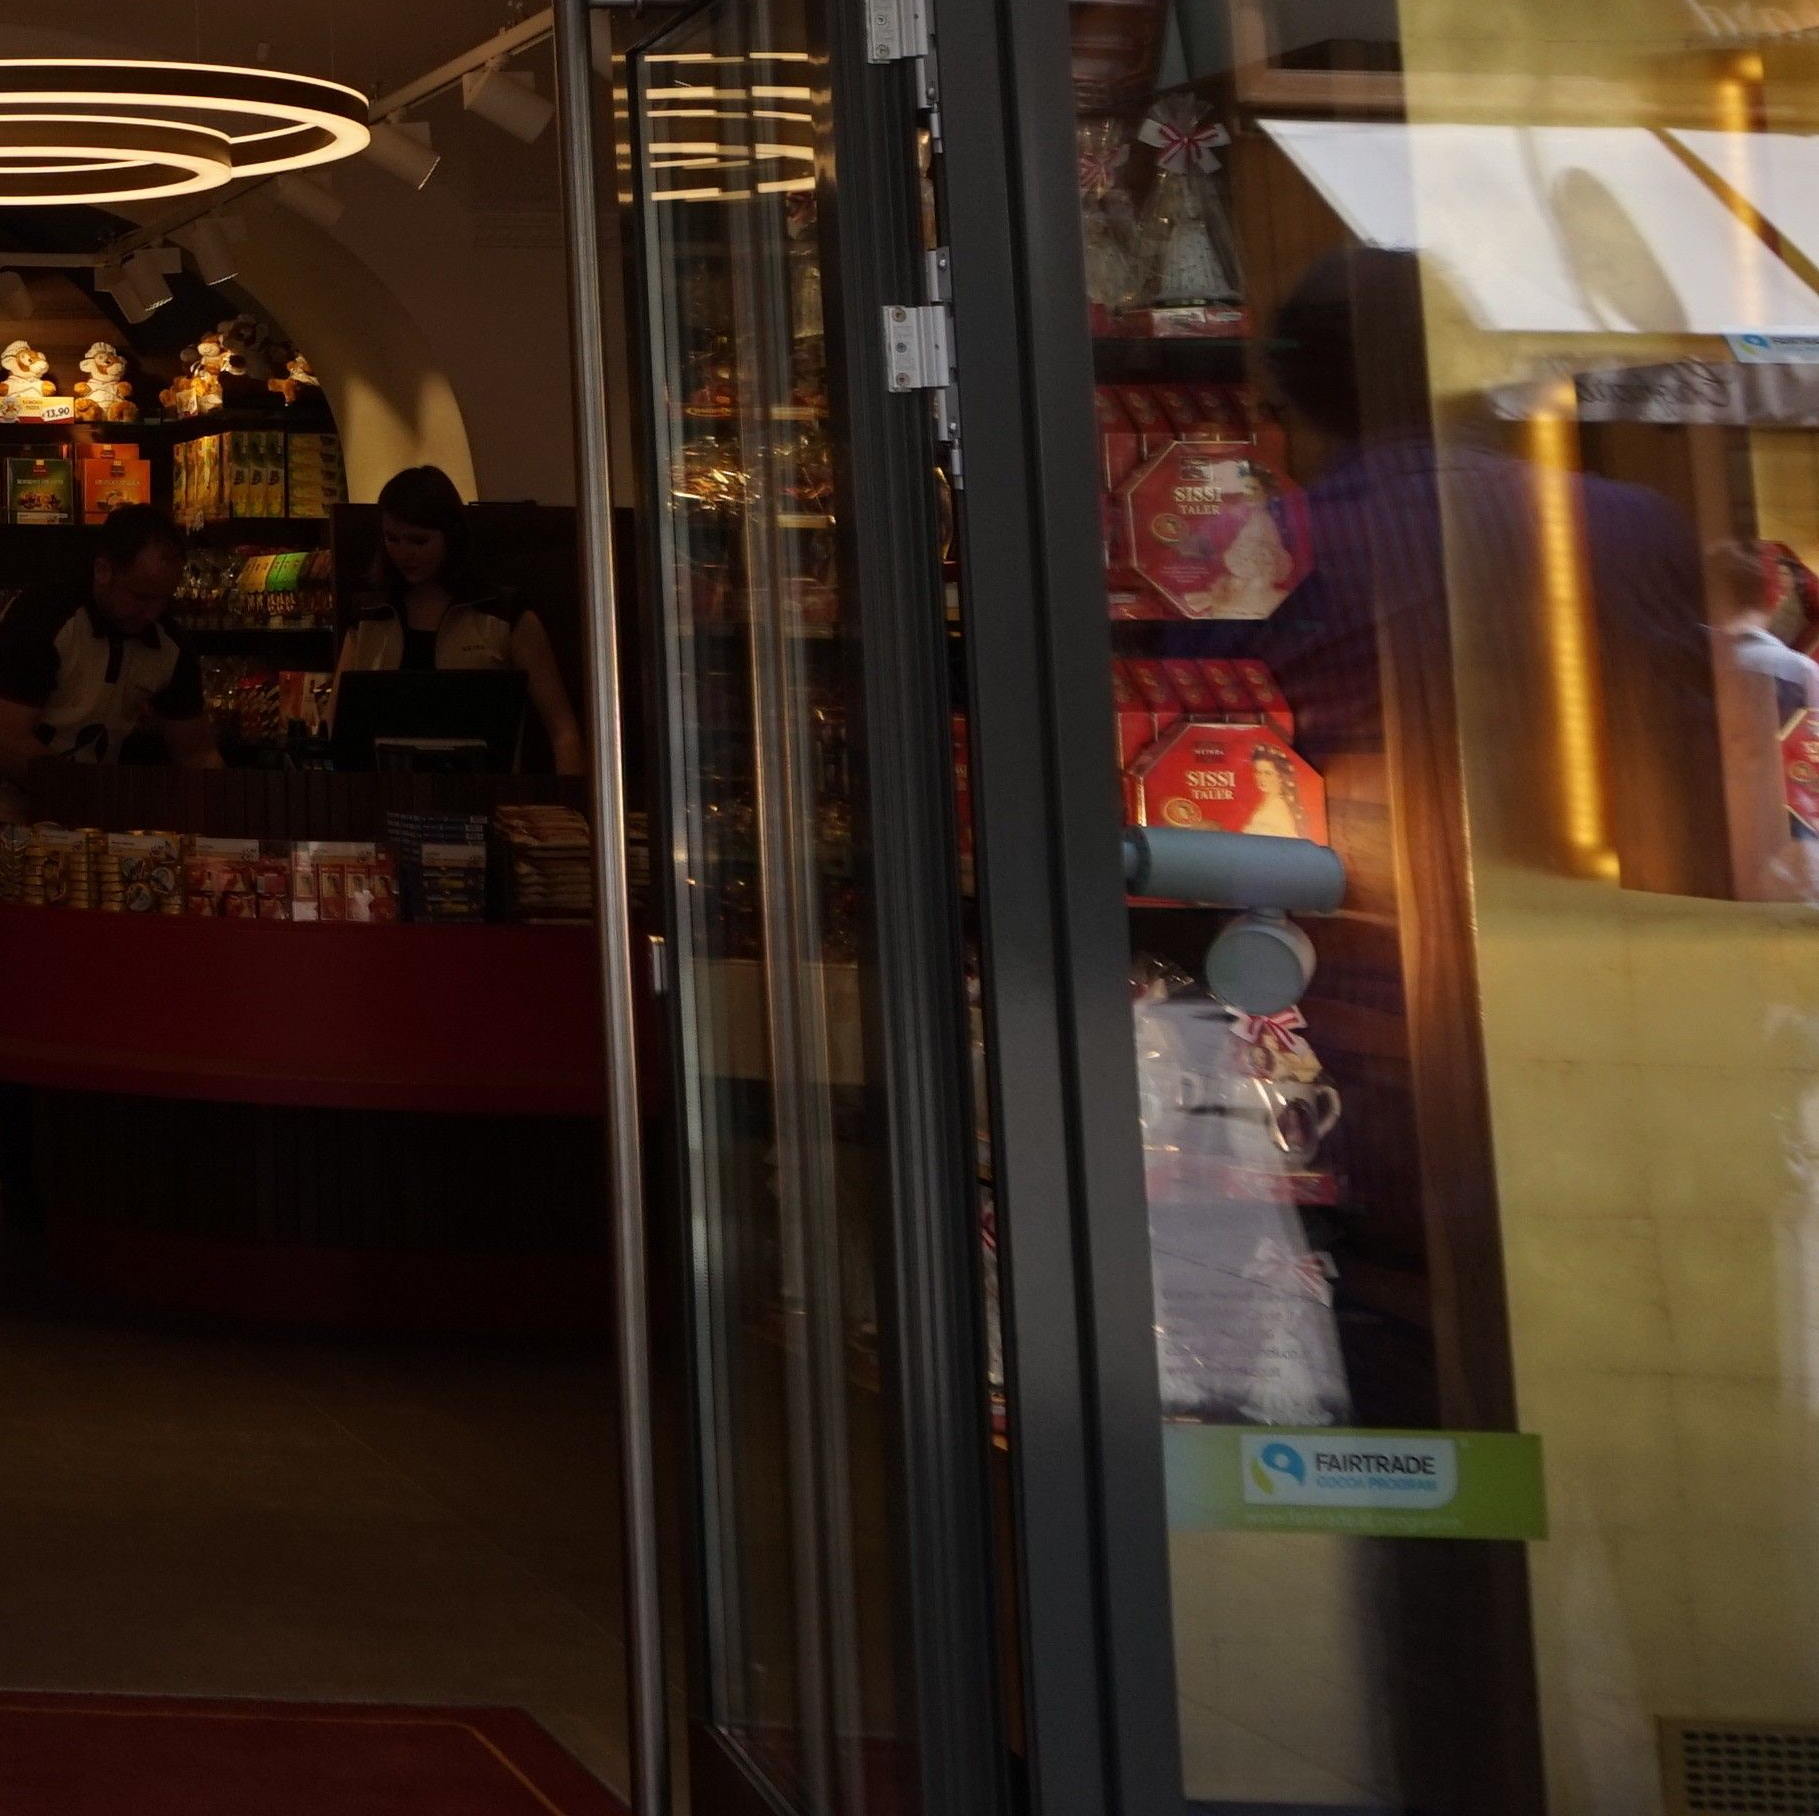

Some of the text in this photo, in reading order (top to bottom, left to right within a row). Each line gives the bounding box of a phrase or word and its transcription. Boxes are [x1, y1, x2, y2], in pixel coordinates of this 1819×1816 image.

[1174, 486, 1223, 503] SISSI
[1179, 504, 1221, 515] TALER
[1186, 770, 1236, 787] SISSI
[1192, 790, 1234, 800] TALER
[1315, 1453, 1436, 1476] FAIRTRADE
